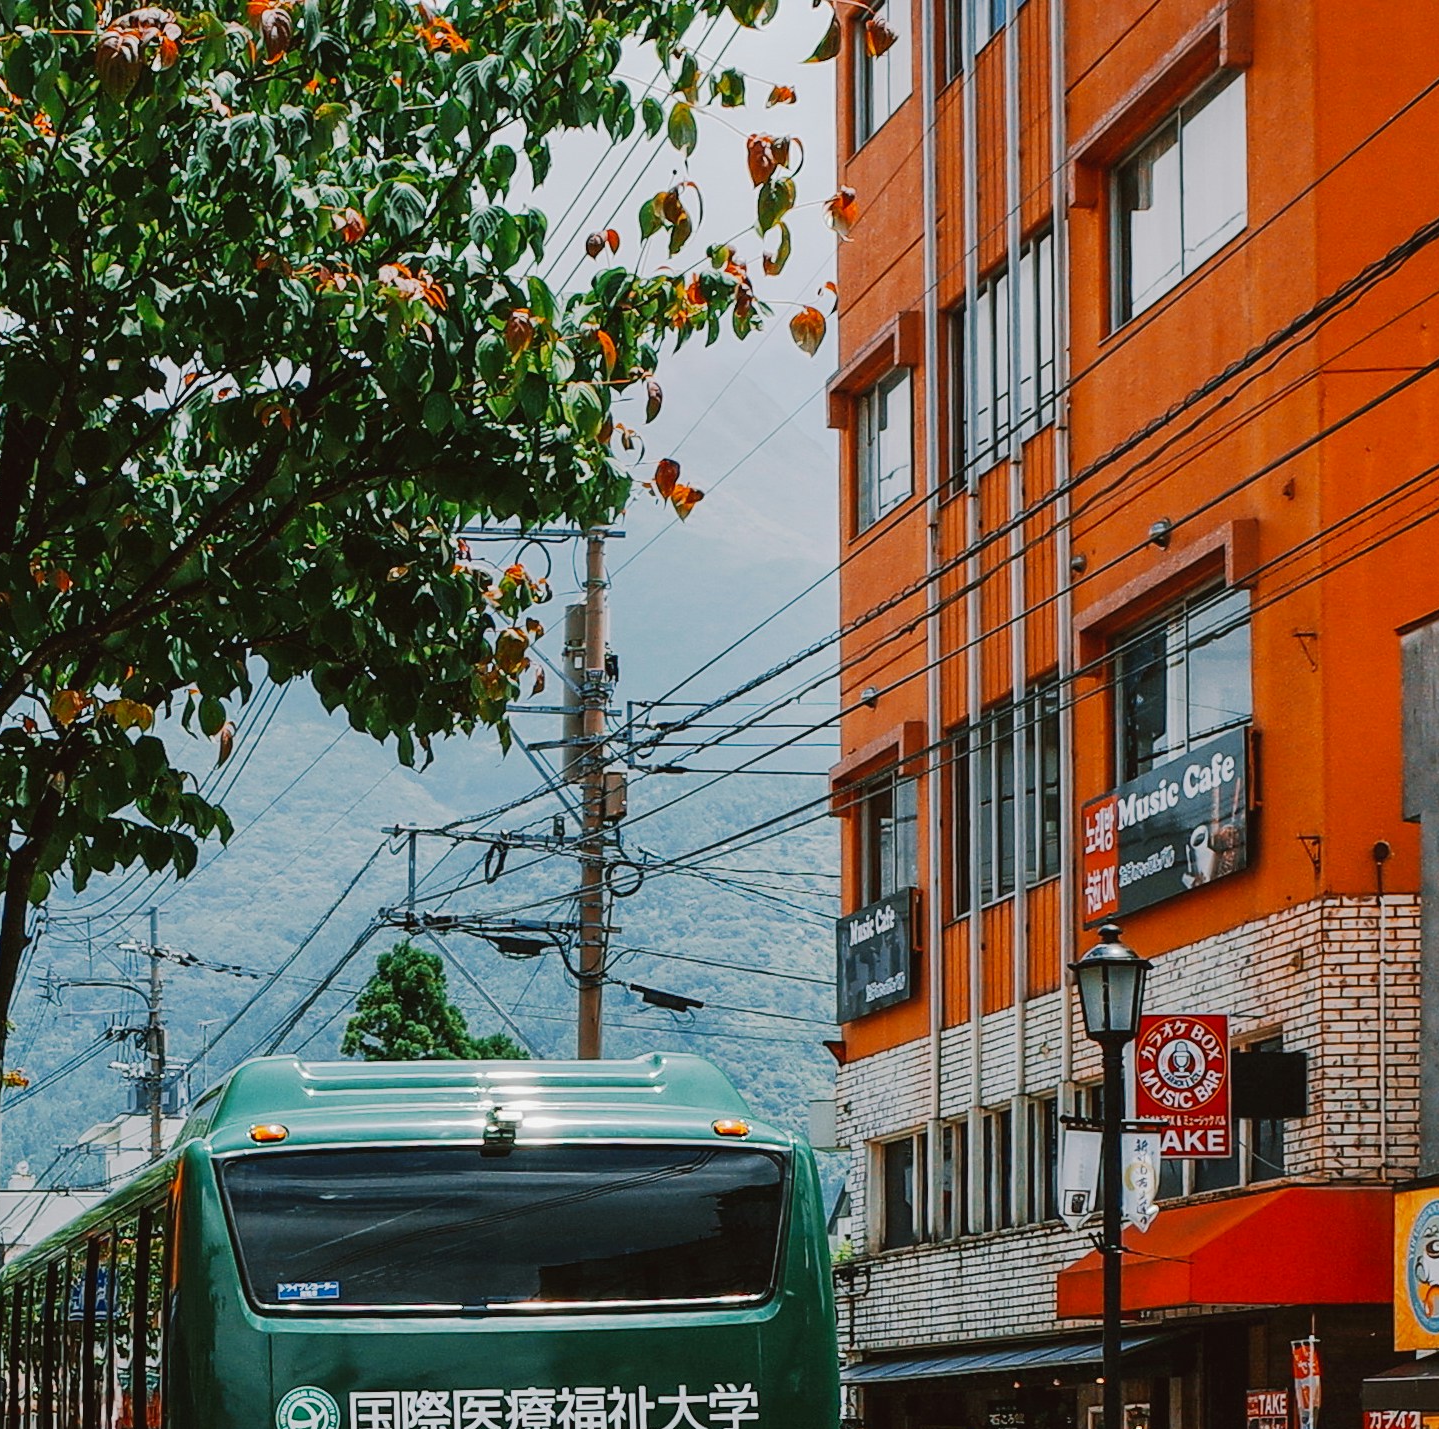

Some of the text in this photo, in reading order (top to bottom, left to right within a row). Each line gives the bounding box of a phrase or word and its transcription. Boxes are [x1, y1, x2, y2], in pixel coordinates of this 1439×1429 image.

[1117, 752, 1235, 830] Music Cafe
[849, 904, 895, 947] Music Cafe
[1141, 1020, 1222, 1062] カラオケ BOX
[1140, 1069, 1193, 1108] MUSIC
[1194, 1070, 1223, 1102] BAR
[1161, 1130, 1226, 1152] AKE
[1258, 1393, 1287, 1414] TAKE
